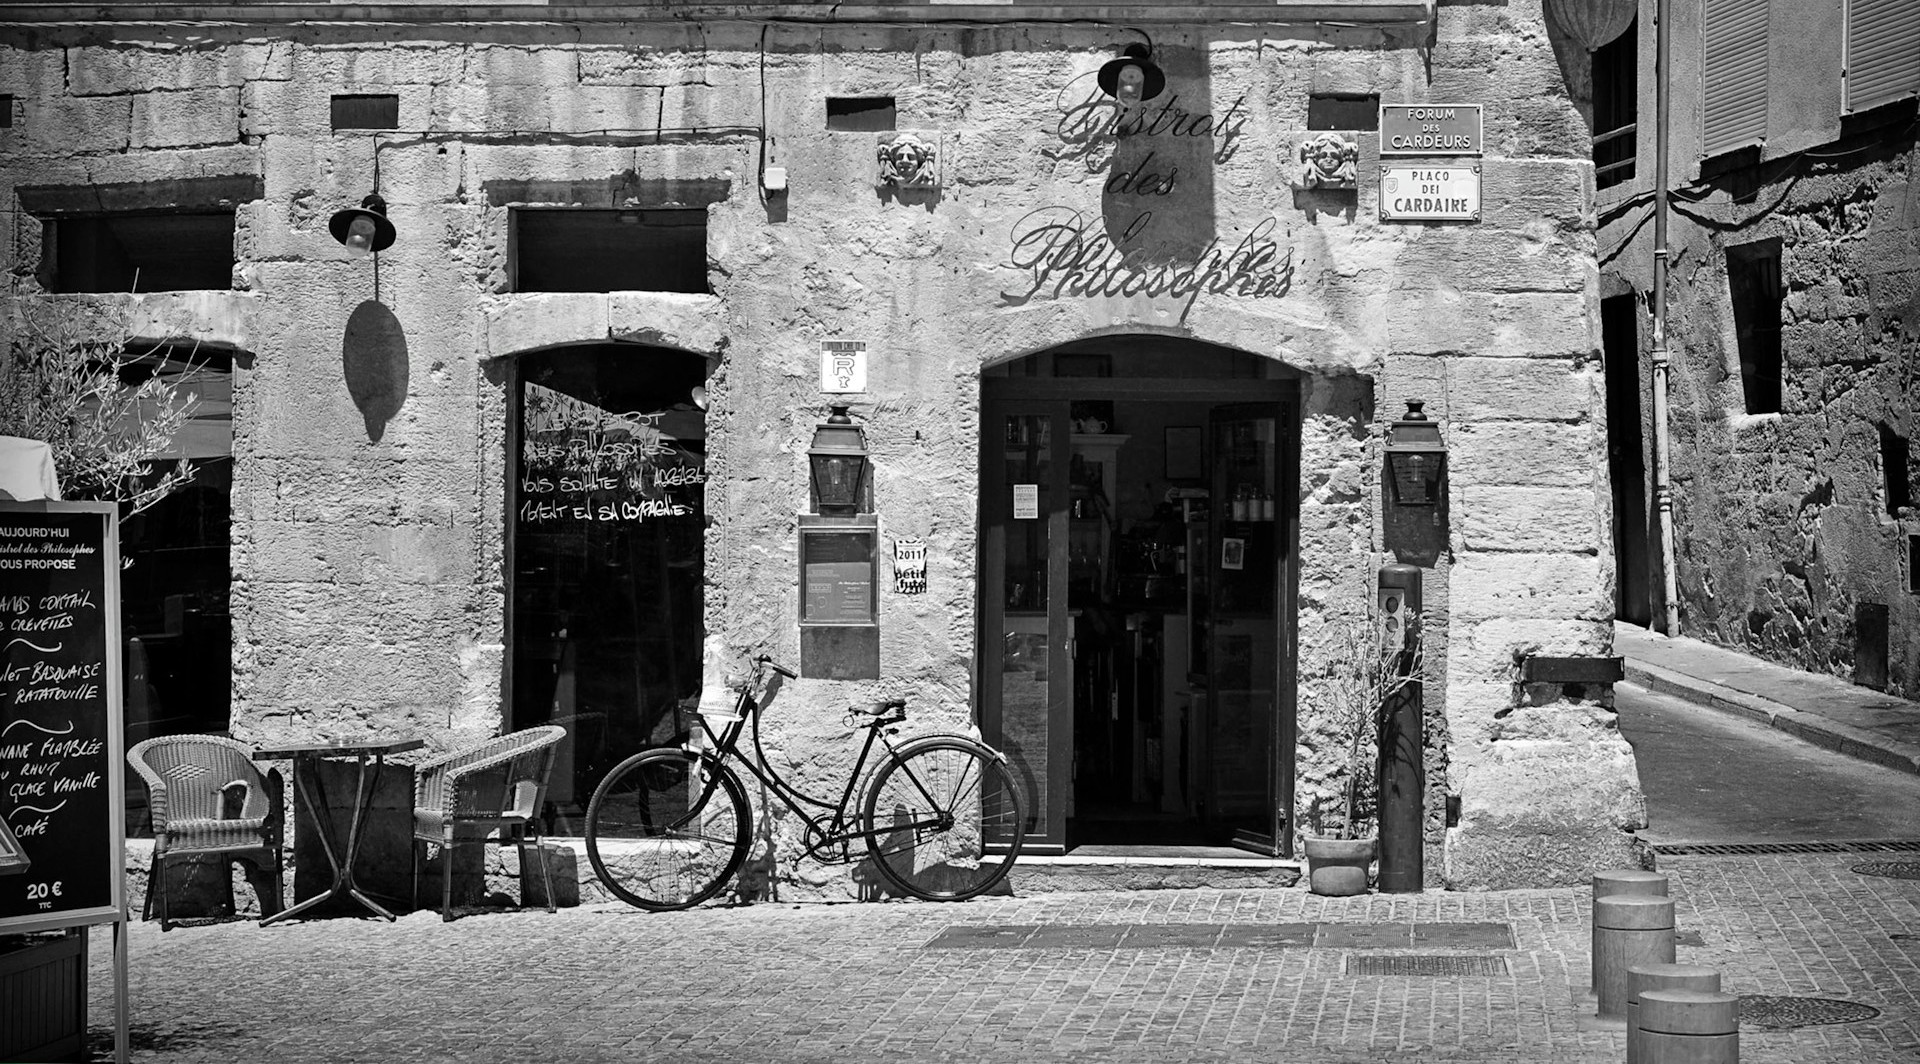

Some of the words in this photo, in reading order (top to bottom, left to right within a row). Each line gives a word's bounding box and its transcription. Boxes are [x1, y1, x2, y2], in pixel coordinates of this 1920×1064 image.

[1041, 70, 1246, 138] Bistrot
[1408, 108, 1455, 120] FORUM
[1422, 123, 1440, 133] DES
[1391, 134, 1471, 149] CARDEURS
[1105, 151, 1178, 196] des
[1412, 171, 1450, 181] PLACO
[1422, 184, 1439, 195] DEI
[1394, 198, 1468, 212] CARDAIRE
[1000, 206, 1295, 290] Philosophes
[522, 467, 554, 493] VOUS
[572, 497, 593, 521] EN
[598, 501, 620, 521] SA
[40, 542, 96, 558] Philosophes
[898, 550, 921, 560] 2011
[24, 559, 76, 569] PROPOSE
[9, 781, 46, 804] GLACE
[26, 883, 48, 900] 20
[39, 901, 52, 909] TTC
